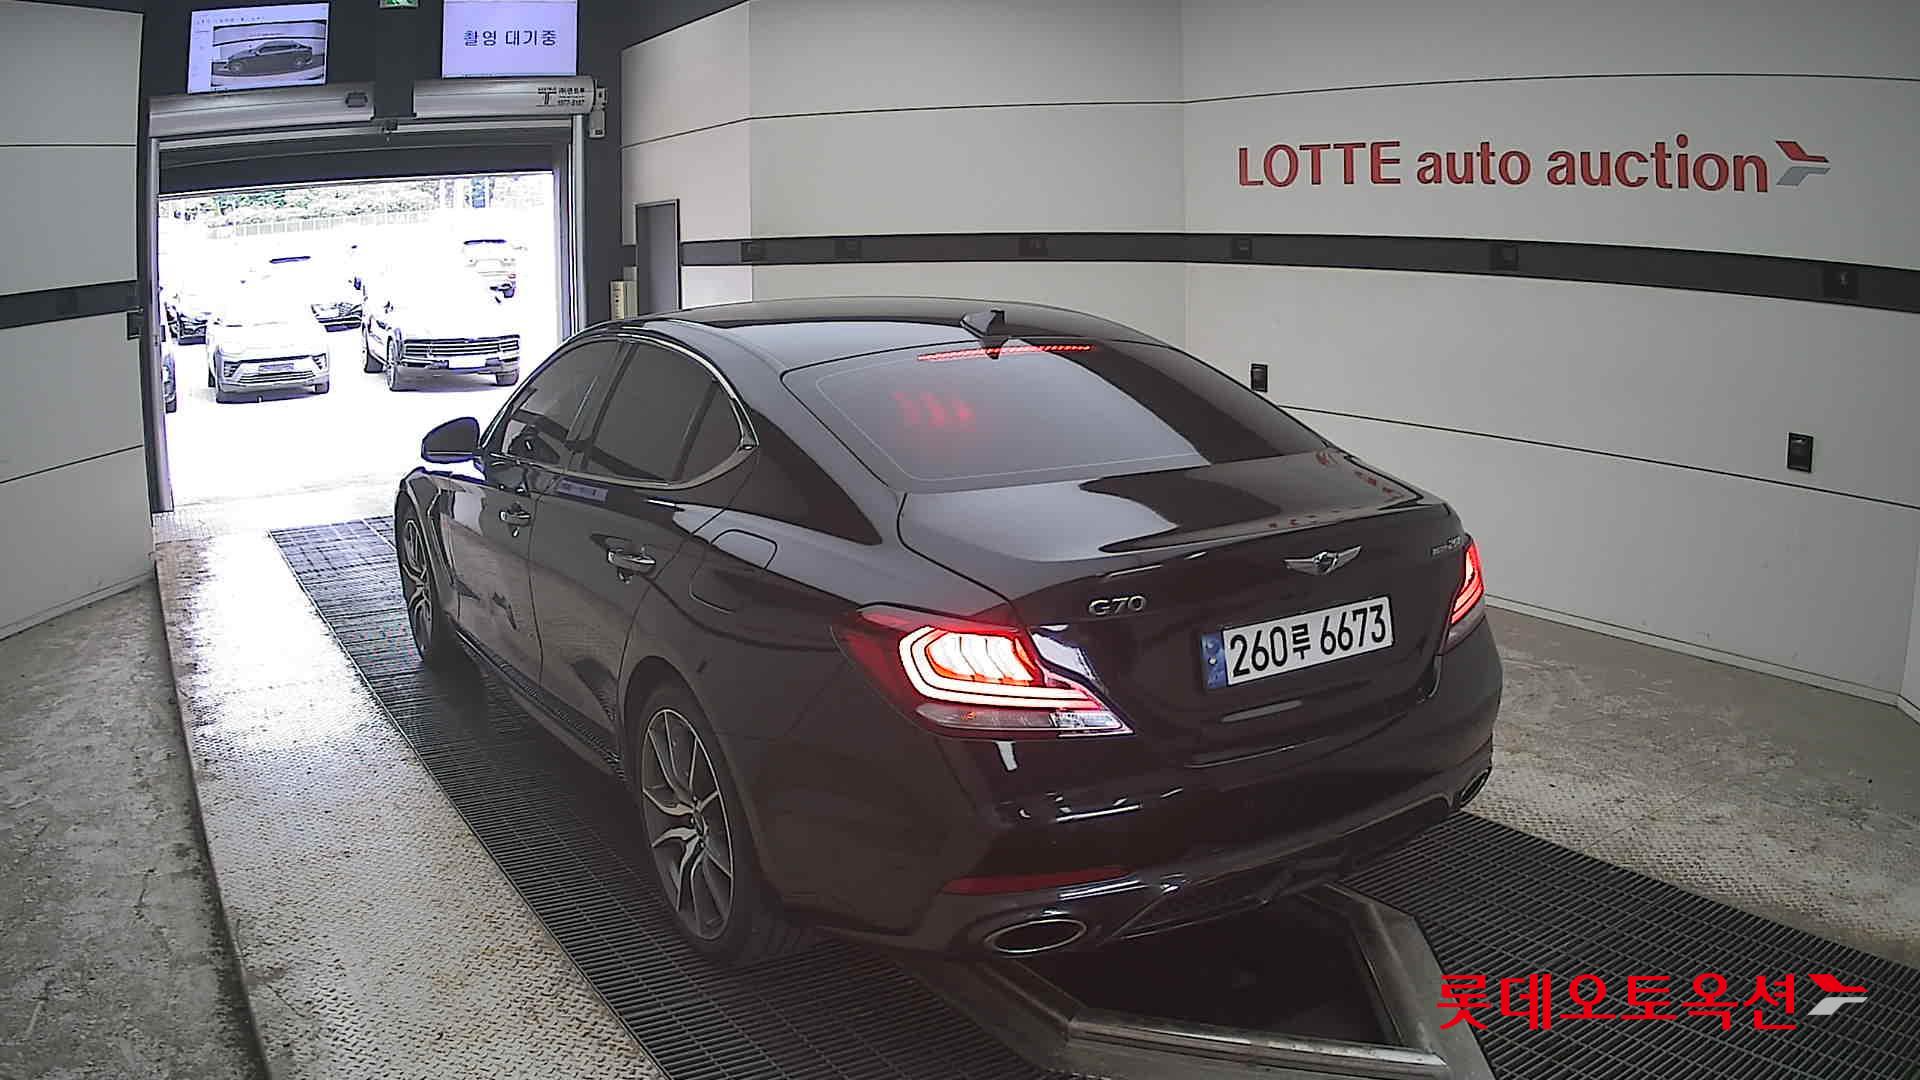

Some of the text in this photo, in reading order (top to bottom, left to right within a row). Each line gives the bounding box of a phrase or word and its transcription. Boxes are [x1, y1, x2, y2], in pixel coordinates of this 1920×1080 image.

[464, 29, 557, 46] 촬영 대기중
[1238, 134, 1768, 193] LOTTE auto auction
[1088, 595, 1147, 616] G70
[1320, 604, 1386, 656] 6673
